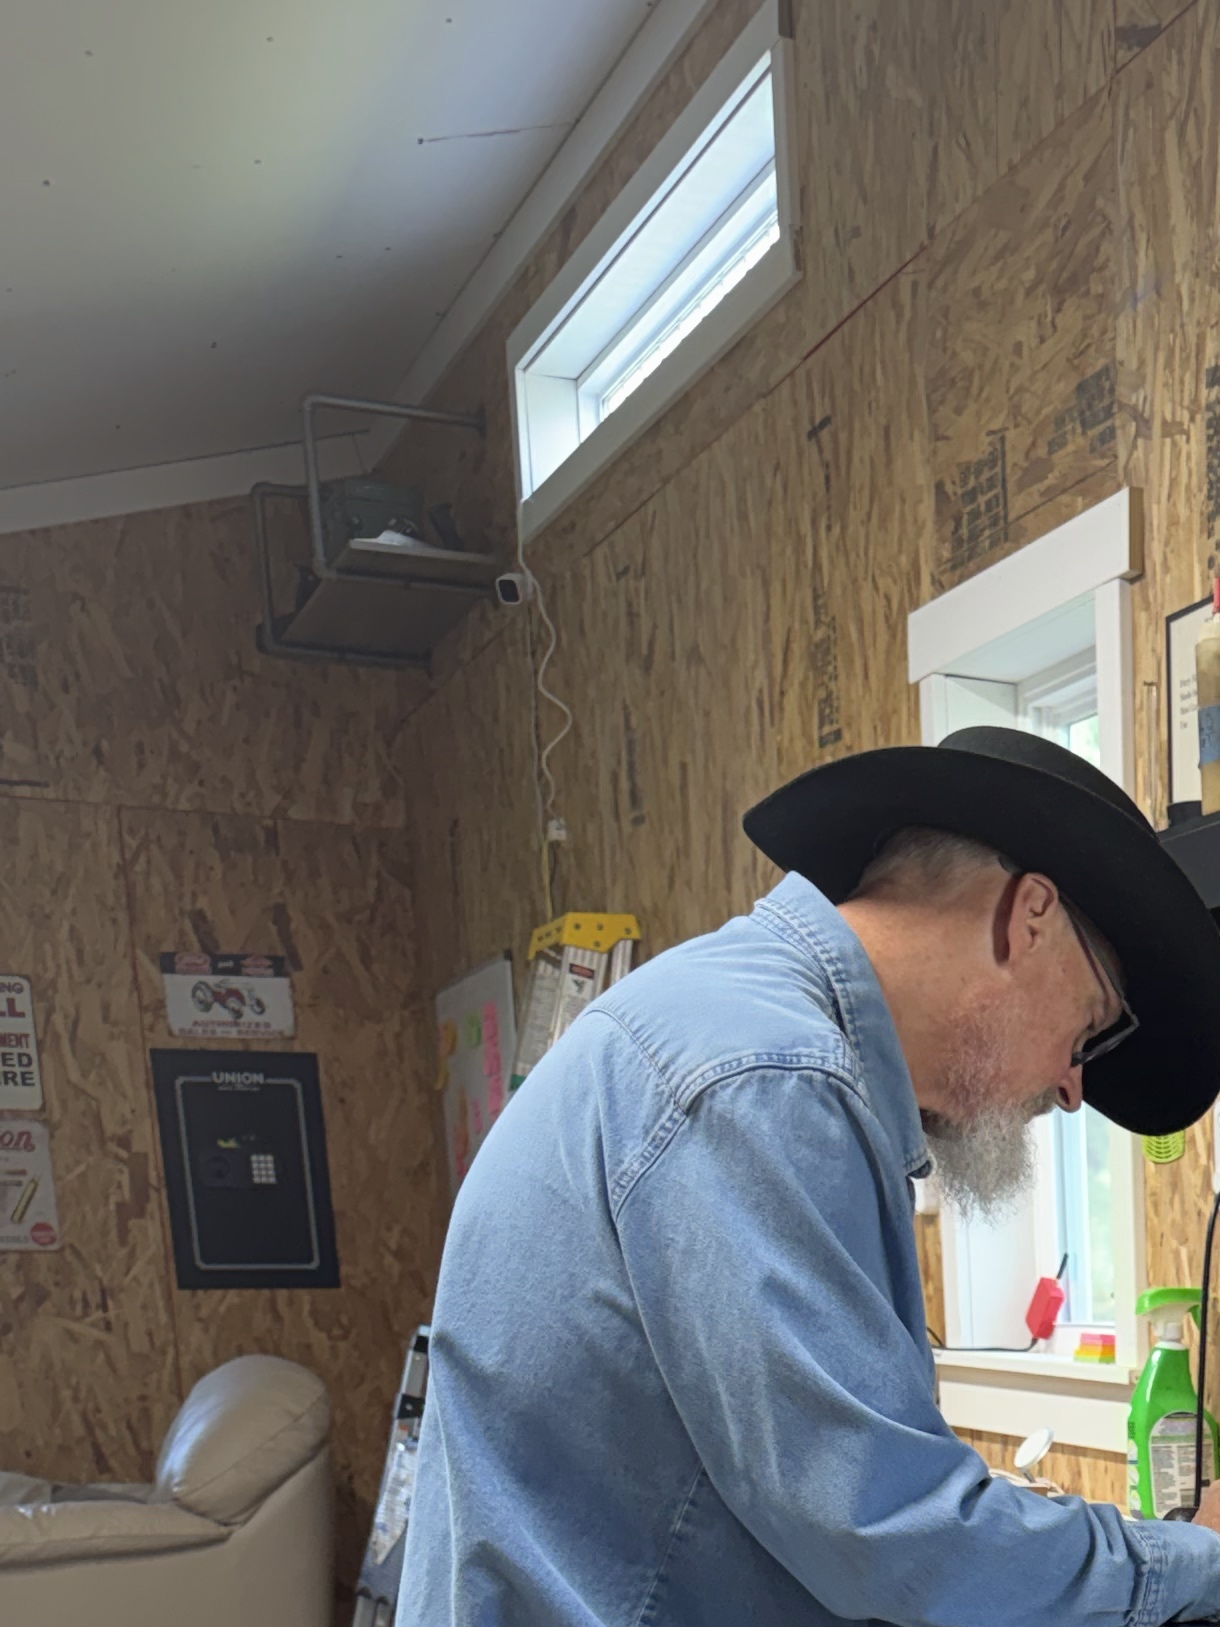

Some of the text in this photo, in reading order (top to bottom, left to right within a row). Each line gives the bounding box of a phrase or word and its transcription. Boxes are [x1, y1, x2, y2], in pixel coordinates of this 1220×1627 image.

[0, 998, 26, 1018] L
[1, 1052, 33, 1068] ED
[0, 1070, 35, 1087] RE
[212, 1071, 265, 1085] UNION
